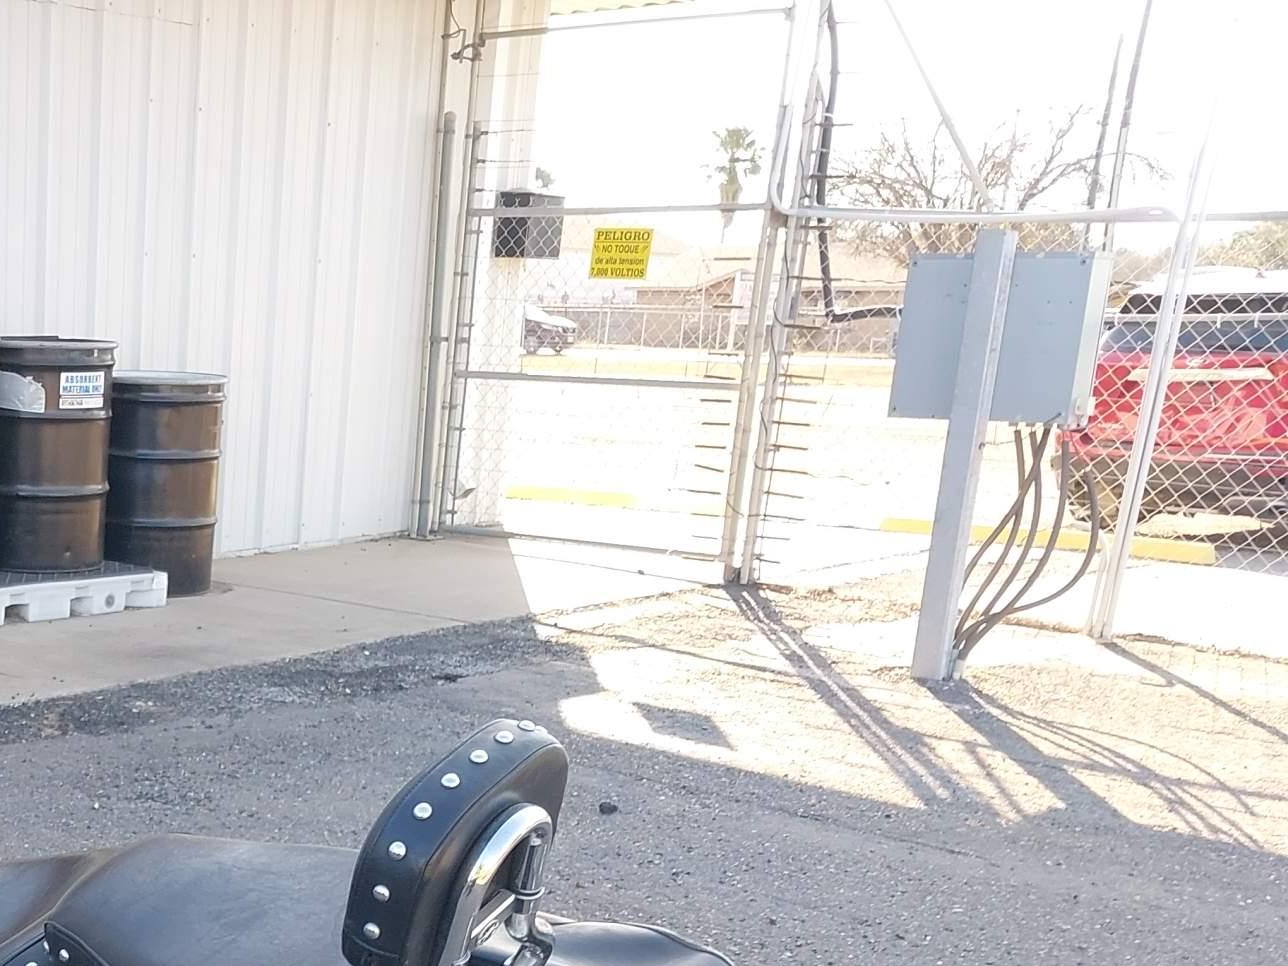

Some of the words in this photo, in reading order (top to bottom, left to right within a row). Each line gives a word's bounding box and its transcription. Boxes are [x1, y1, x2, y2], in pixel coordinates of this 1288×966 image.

[597, 231, 650, 240] PELIGRO
[602, 244, 612, 253] NO
[615, 244, 640, 253] TOQUE
[611, 267, 644, 277] VOLTIOS
